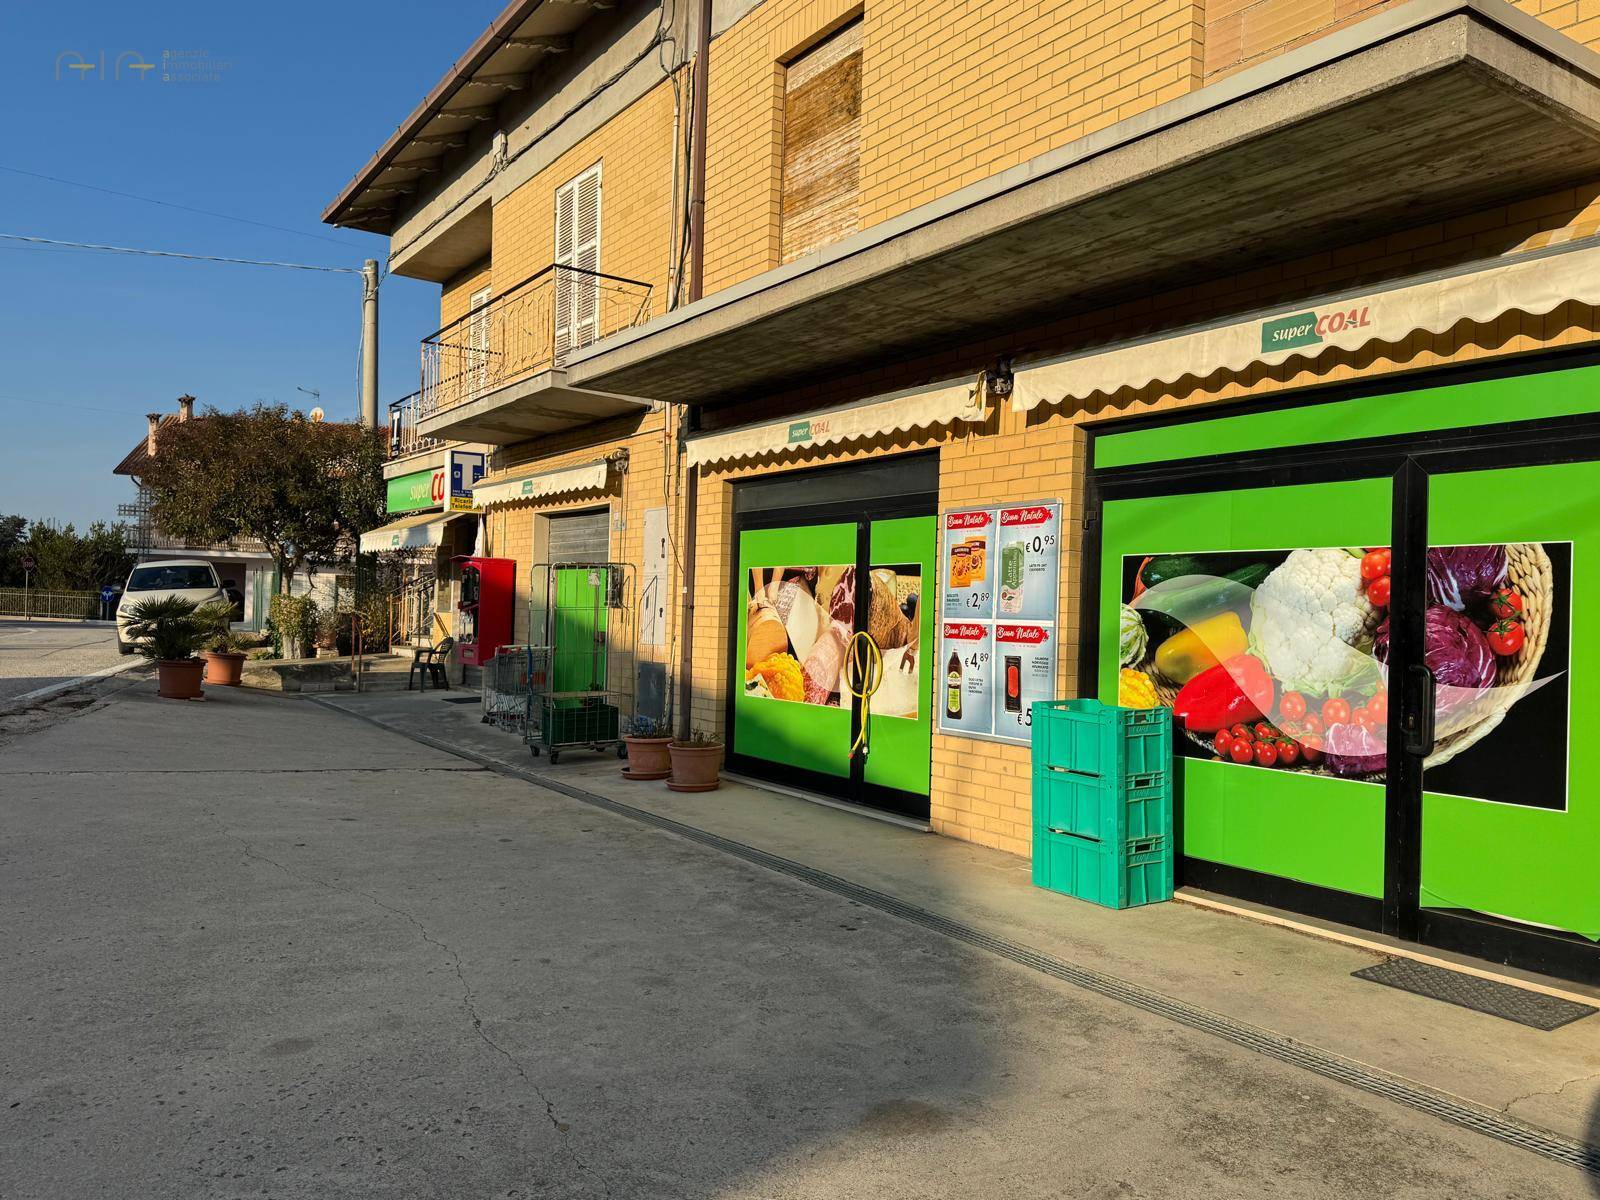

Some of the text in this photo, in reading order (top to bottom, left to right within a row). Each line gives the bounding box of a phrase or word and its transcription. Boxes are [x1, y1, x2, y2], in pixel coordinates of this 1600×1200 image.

[1272, 306, 1371, 342] super COAL
[791, 420, 829, 437] super COAL
[453, 453, 483, 491] T
[409, 472, 445, 502] super CO
[947, 513, 984, 528] Buon Natale
[1001, 509, 1044, 524] Buon Natale
[944, 624, 981, 637] Buon Natale
[996, 626, 1040, 640] Buon Natale
[1017, 707, 1033, 727] €5
